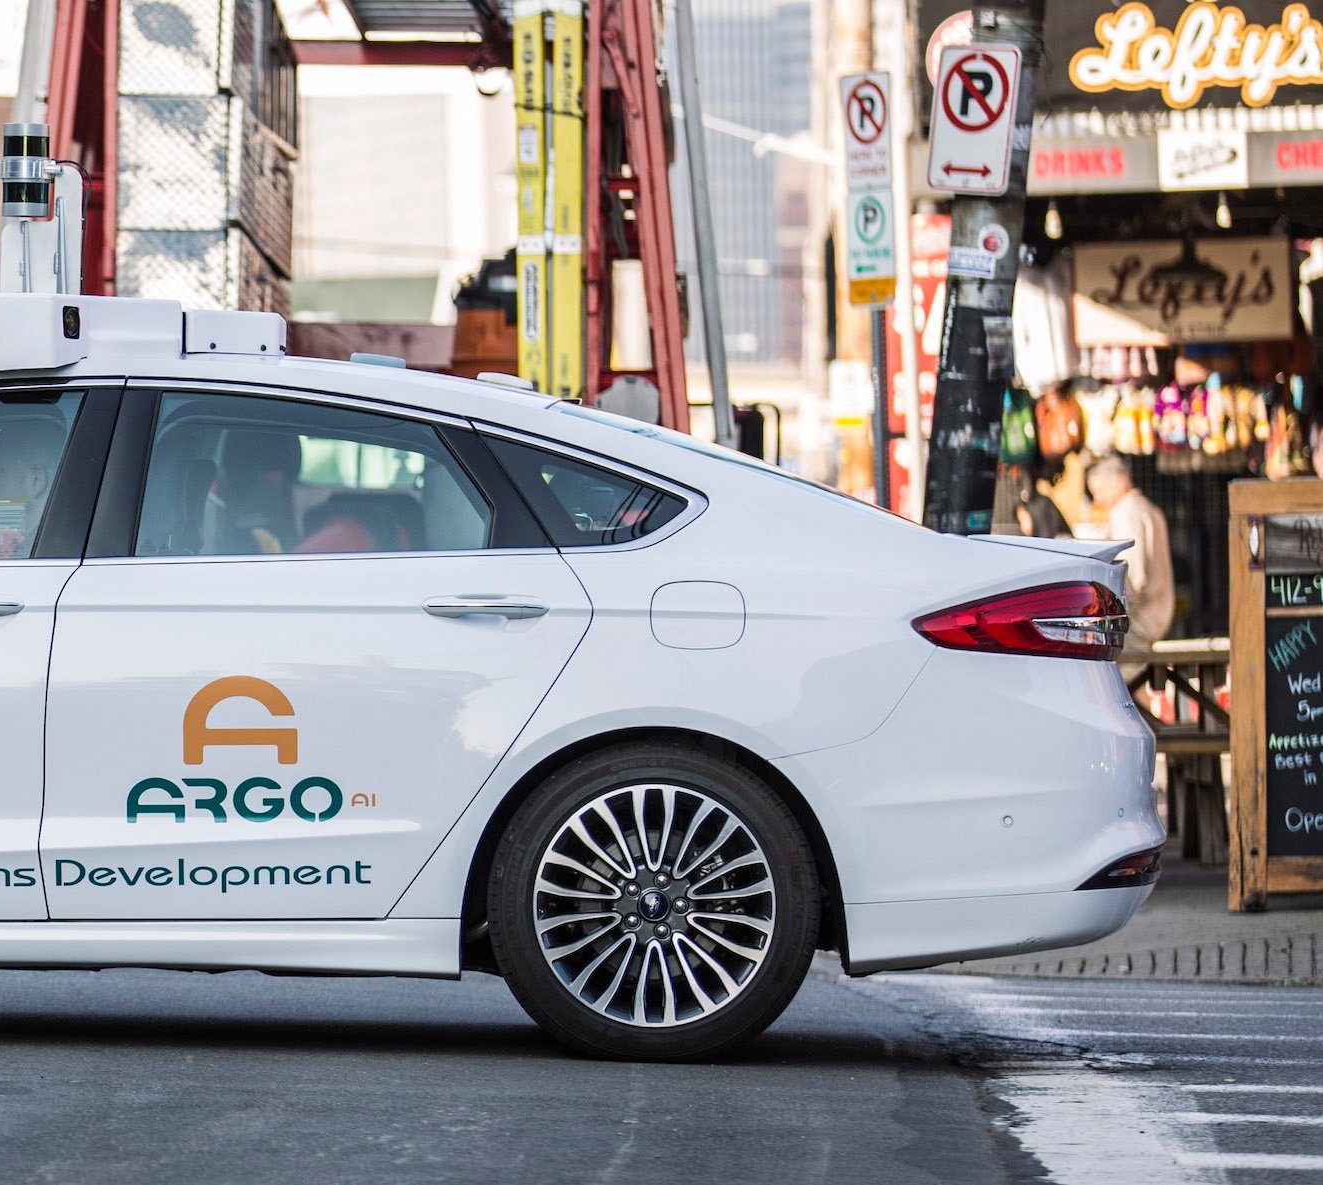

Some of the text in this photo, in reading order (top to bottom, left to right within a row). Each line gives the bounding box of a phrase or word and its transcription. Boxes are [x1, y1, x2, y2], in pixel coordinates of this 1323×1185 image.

[1073, 4, 1323, 106] Lefty's
[1034, 148, 1125, 178] DRINKS
[1267, 619, 1318, 672] HAPPY
[1287, 672, 1321, 695] Wed
[126, 776, 376, 824] ARGO AI
[54, 858, 372, 894] Development
